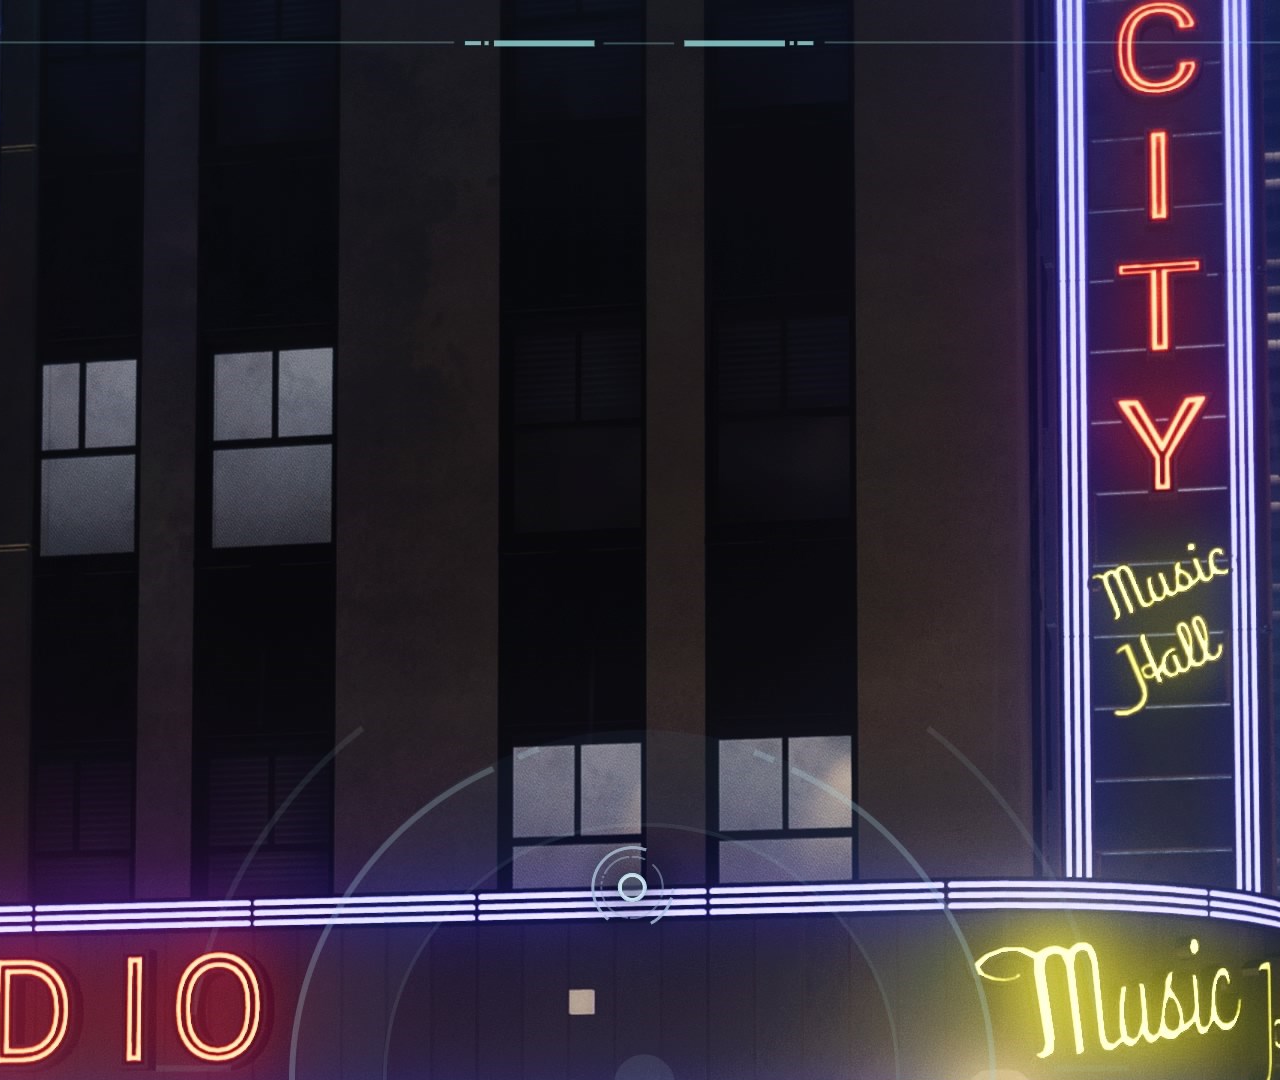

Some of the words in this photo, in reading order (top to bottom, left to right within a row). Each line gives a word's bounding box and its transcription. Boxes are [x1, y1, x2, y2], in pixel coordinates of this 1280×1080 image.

[1118, 2, 1206, 492] CITY
[1092, 542, 1229, 620] Music
[1114, 615, 1223, 717] Hall
[974, 938, 1242, 1059] Music
